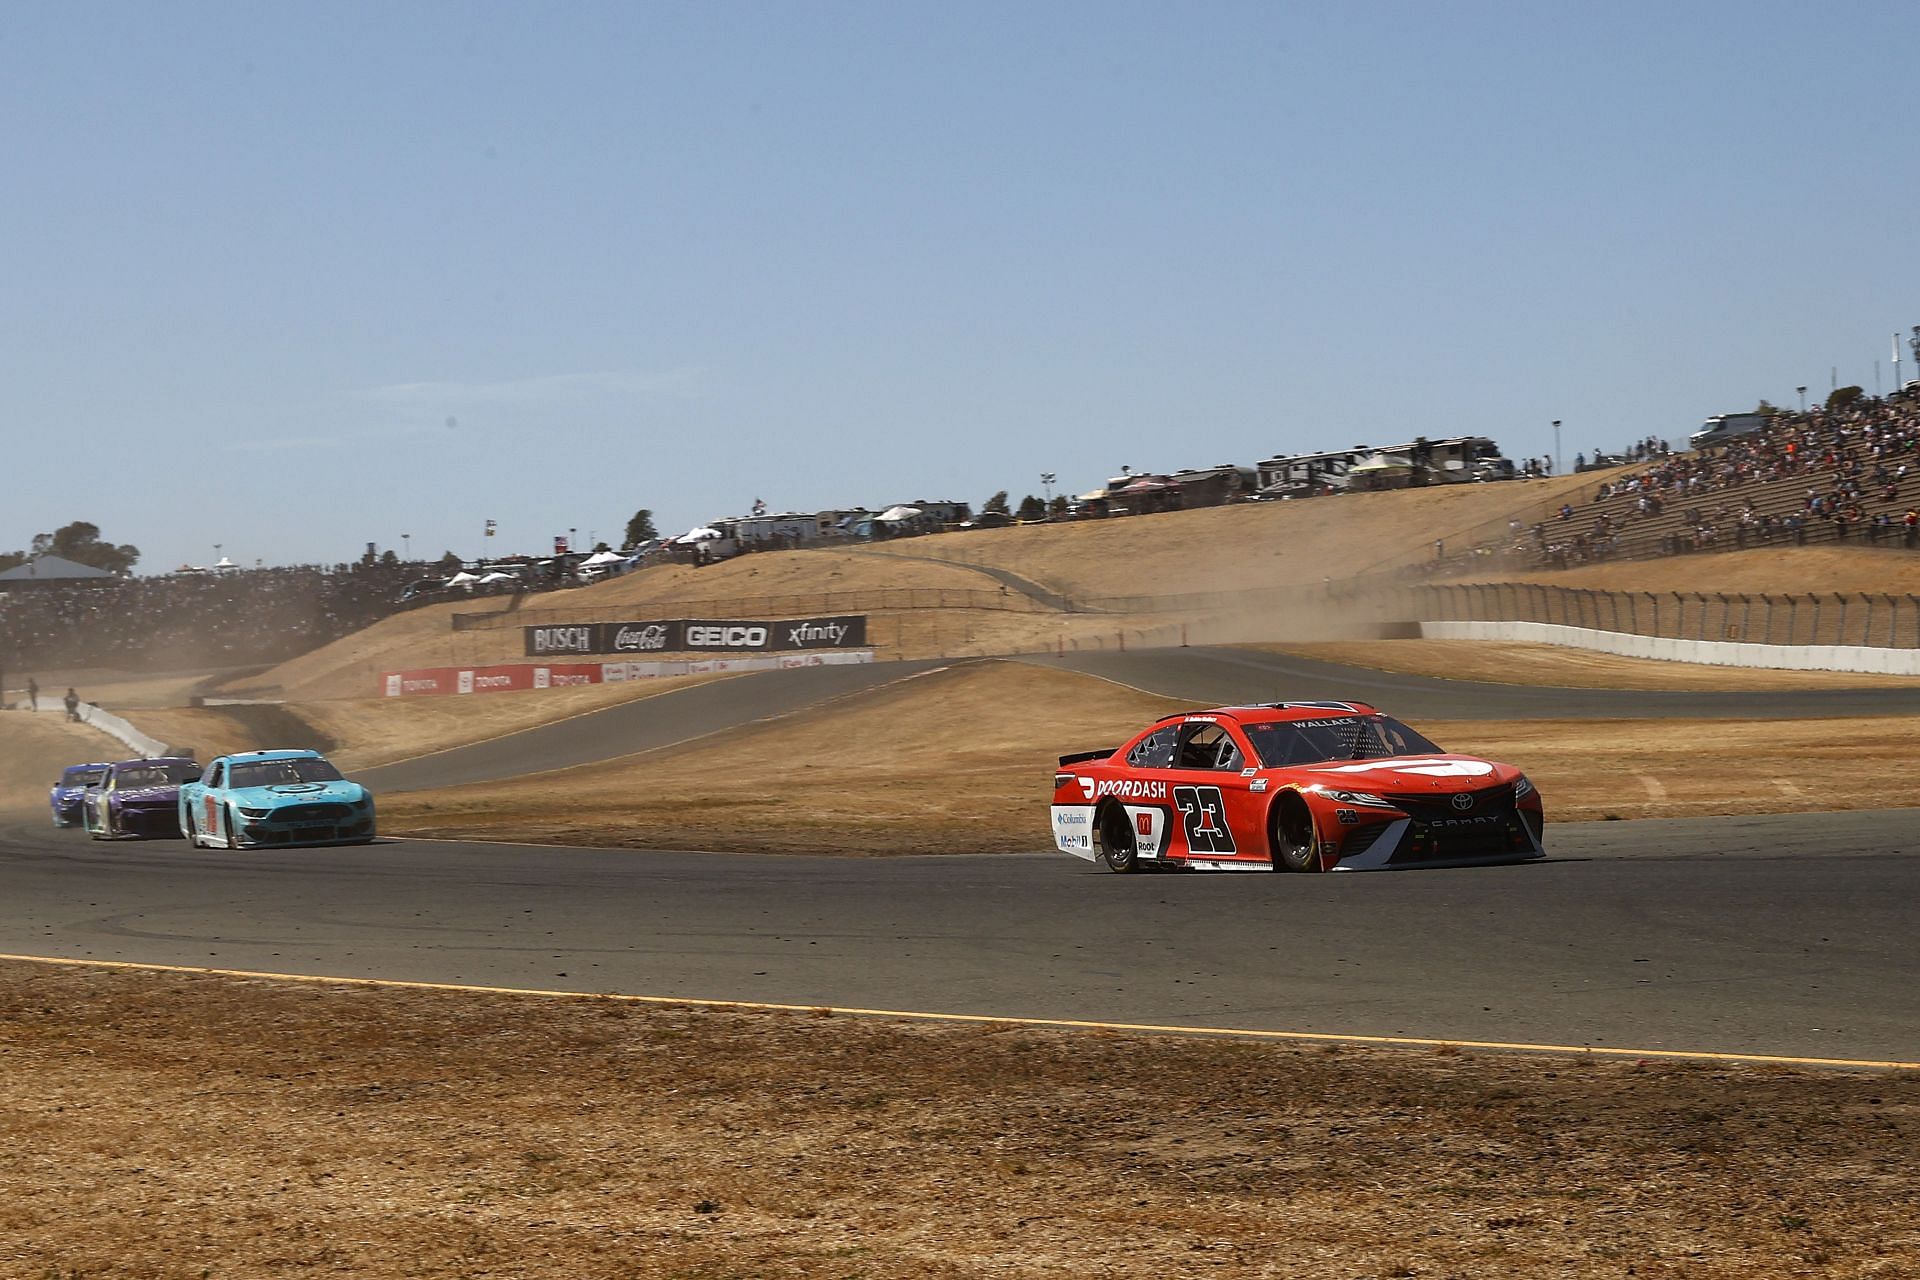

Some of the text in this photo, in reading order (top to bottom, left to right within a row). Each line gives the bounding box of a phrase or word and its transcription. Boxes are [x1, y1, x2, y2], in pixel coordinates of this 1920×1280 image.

[534, 627, 591, 653] BUSCH
[686, 625, 768, 647] GEICO
[788, 621, 849, 648] xfinity
[403, 678, 437, 691] TOYOTA
[475, 674, 512, 688] TOYOTA
[551, 673, 590, 687] TOYOTA
[1292, 717, 1357, 730] WALLACE
[1097, 779, 1167, 798] DOORDASH
[1063, 813, 1087, 824] Columbia
[1173, 785, 1237, 855] 23
[1431, 814, 1500, 828] CAMRY
[1060, 835, 1081, 848] Mobil
